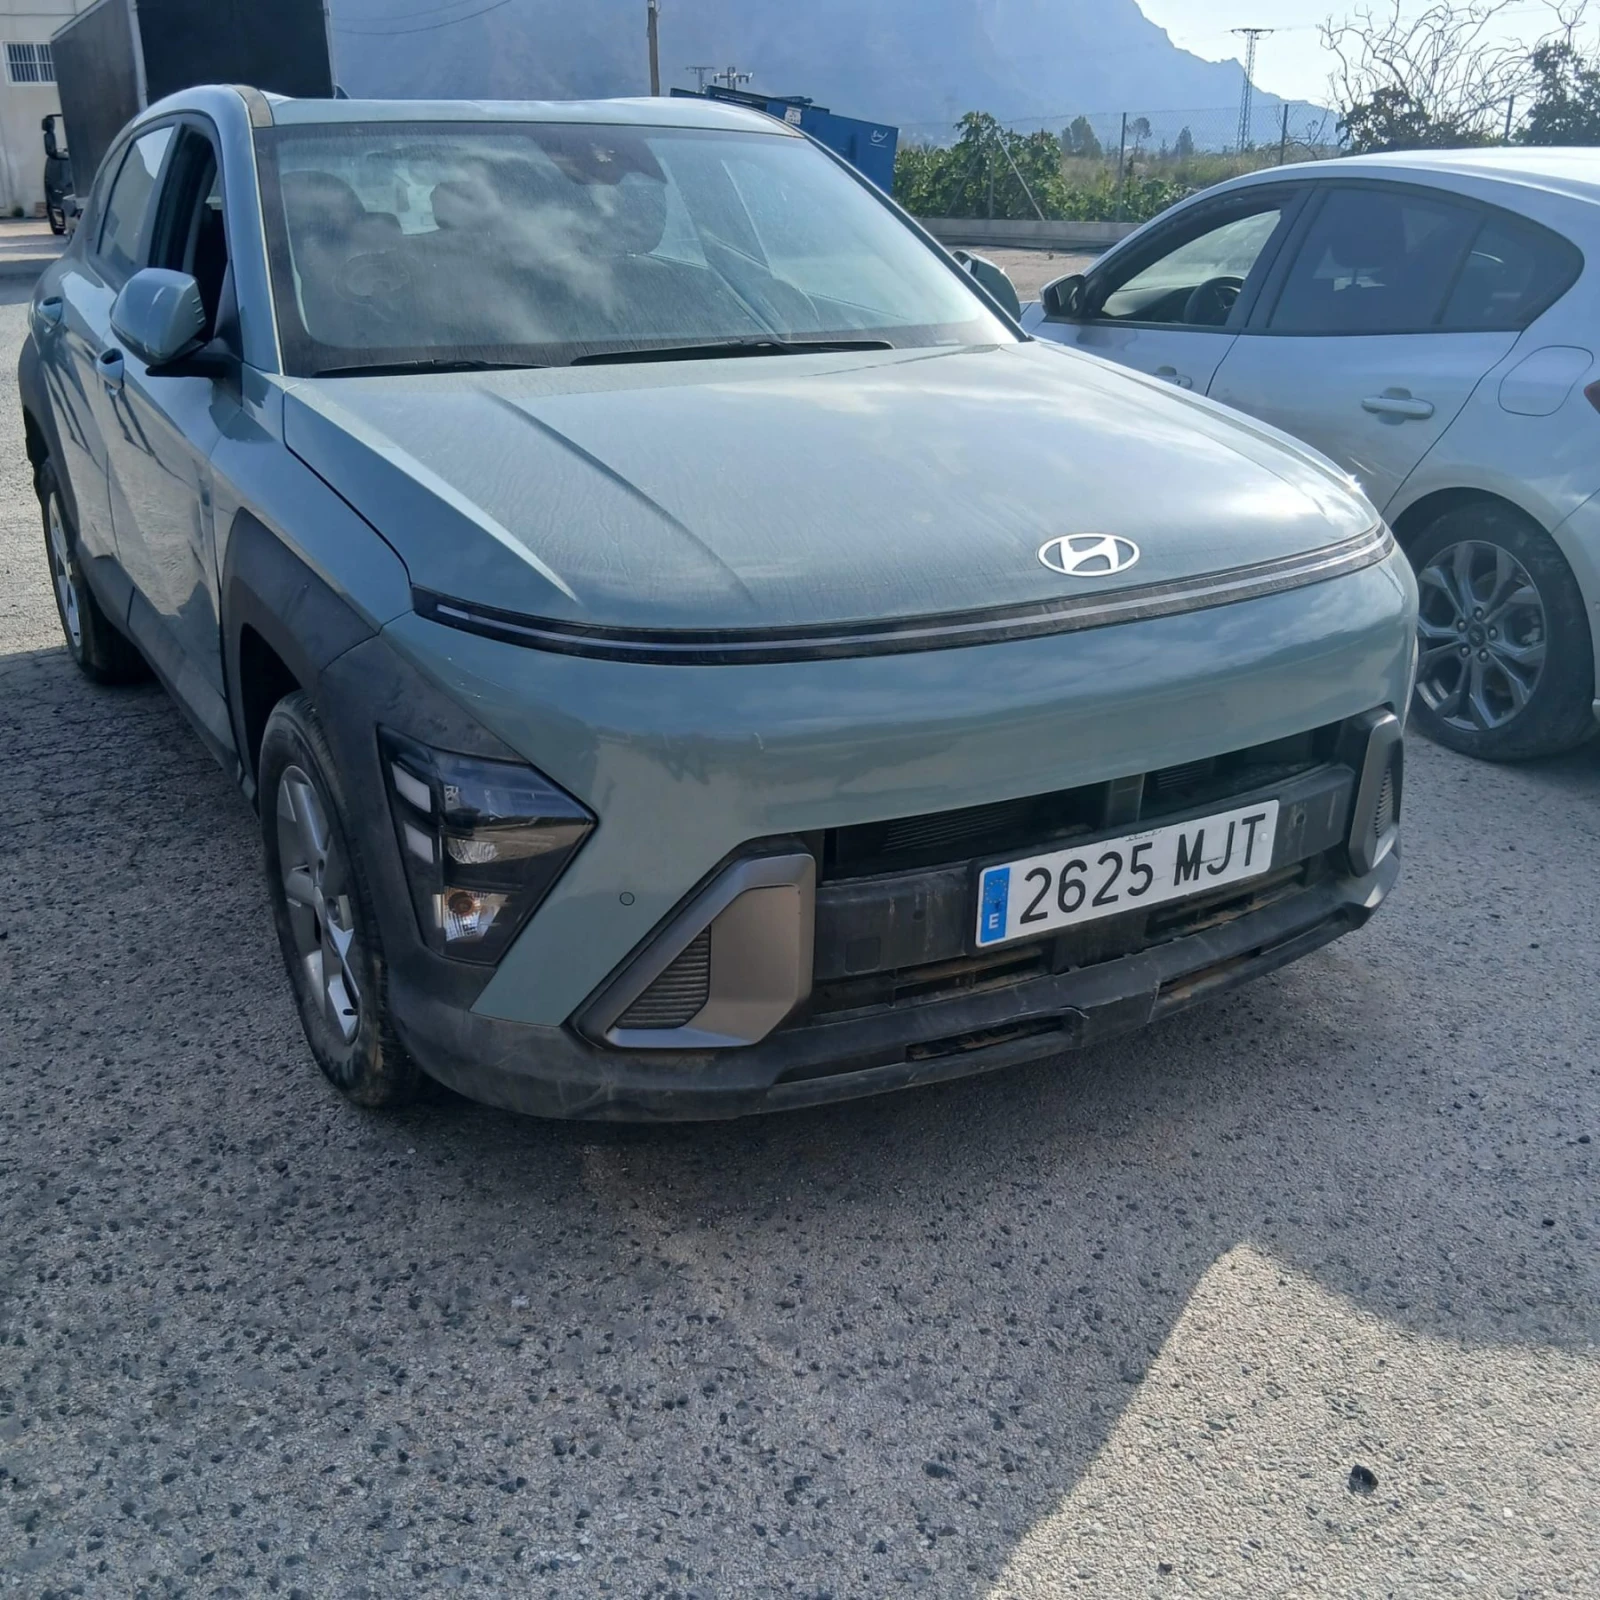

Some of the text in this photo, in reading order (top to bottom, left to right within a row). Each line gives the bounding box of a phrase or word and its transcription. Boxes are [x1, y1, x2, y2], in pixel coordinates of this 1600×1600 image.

[1019, 812, 1266, 925] 2625 MJT
[988, 914, 1000, 930] E
